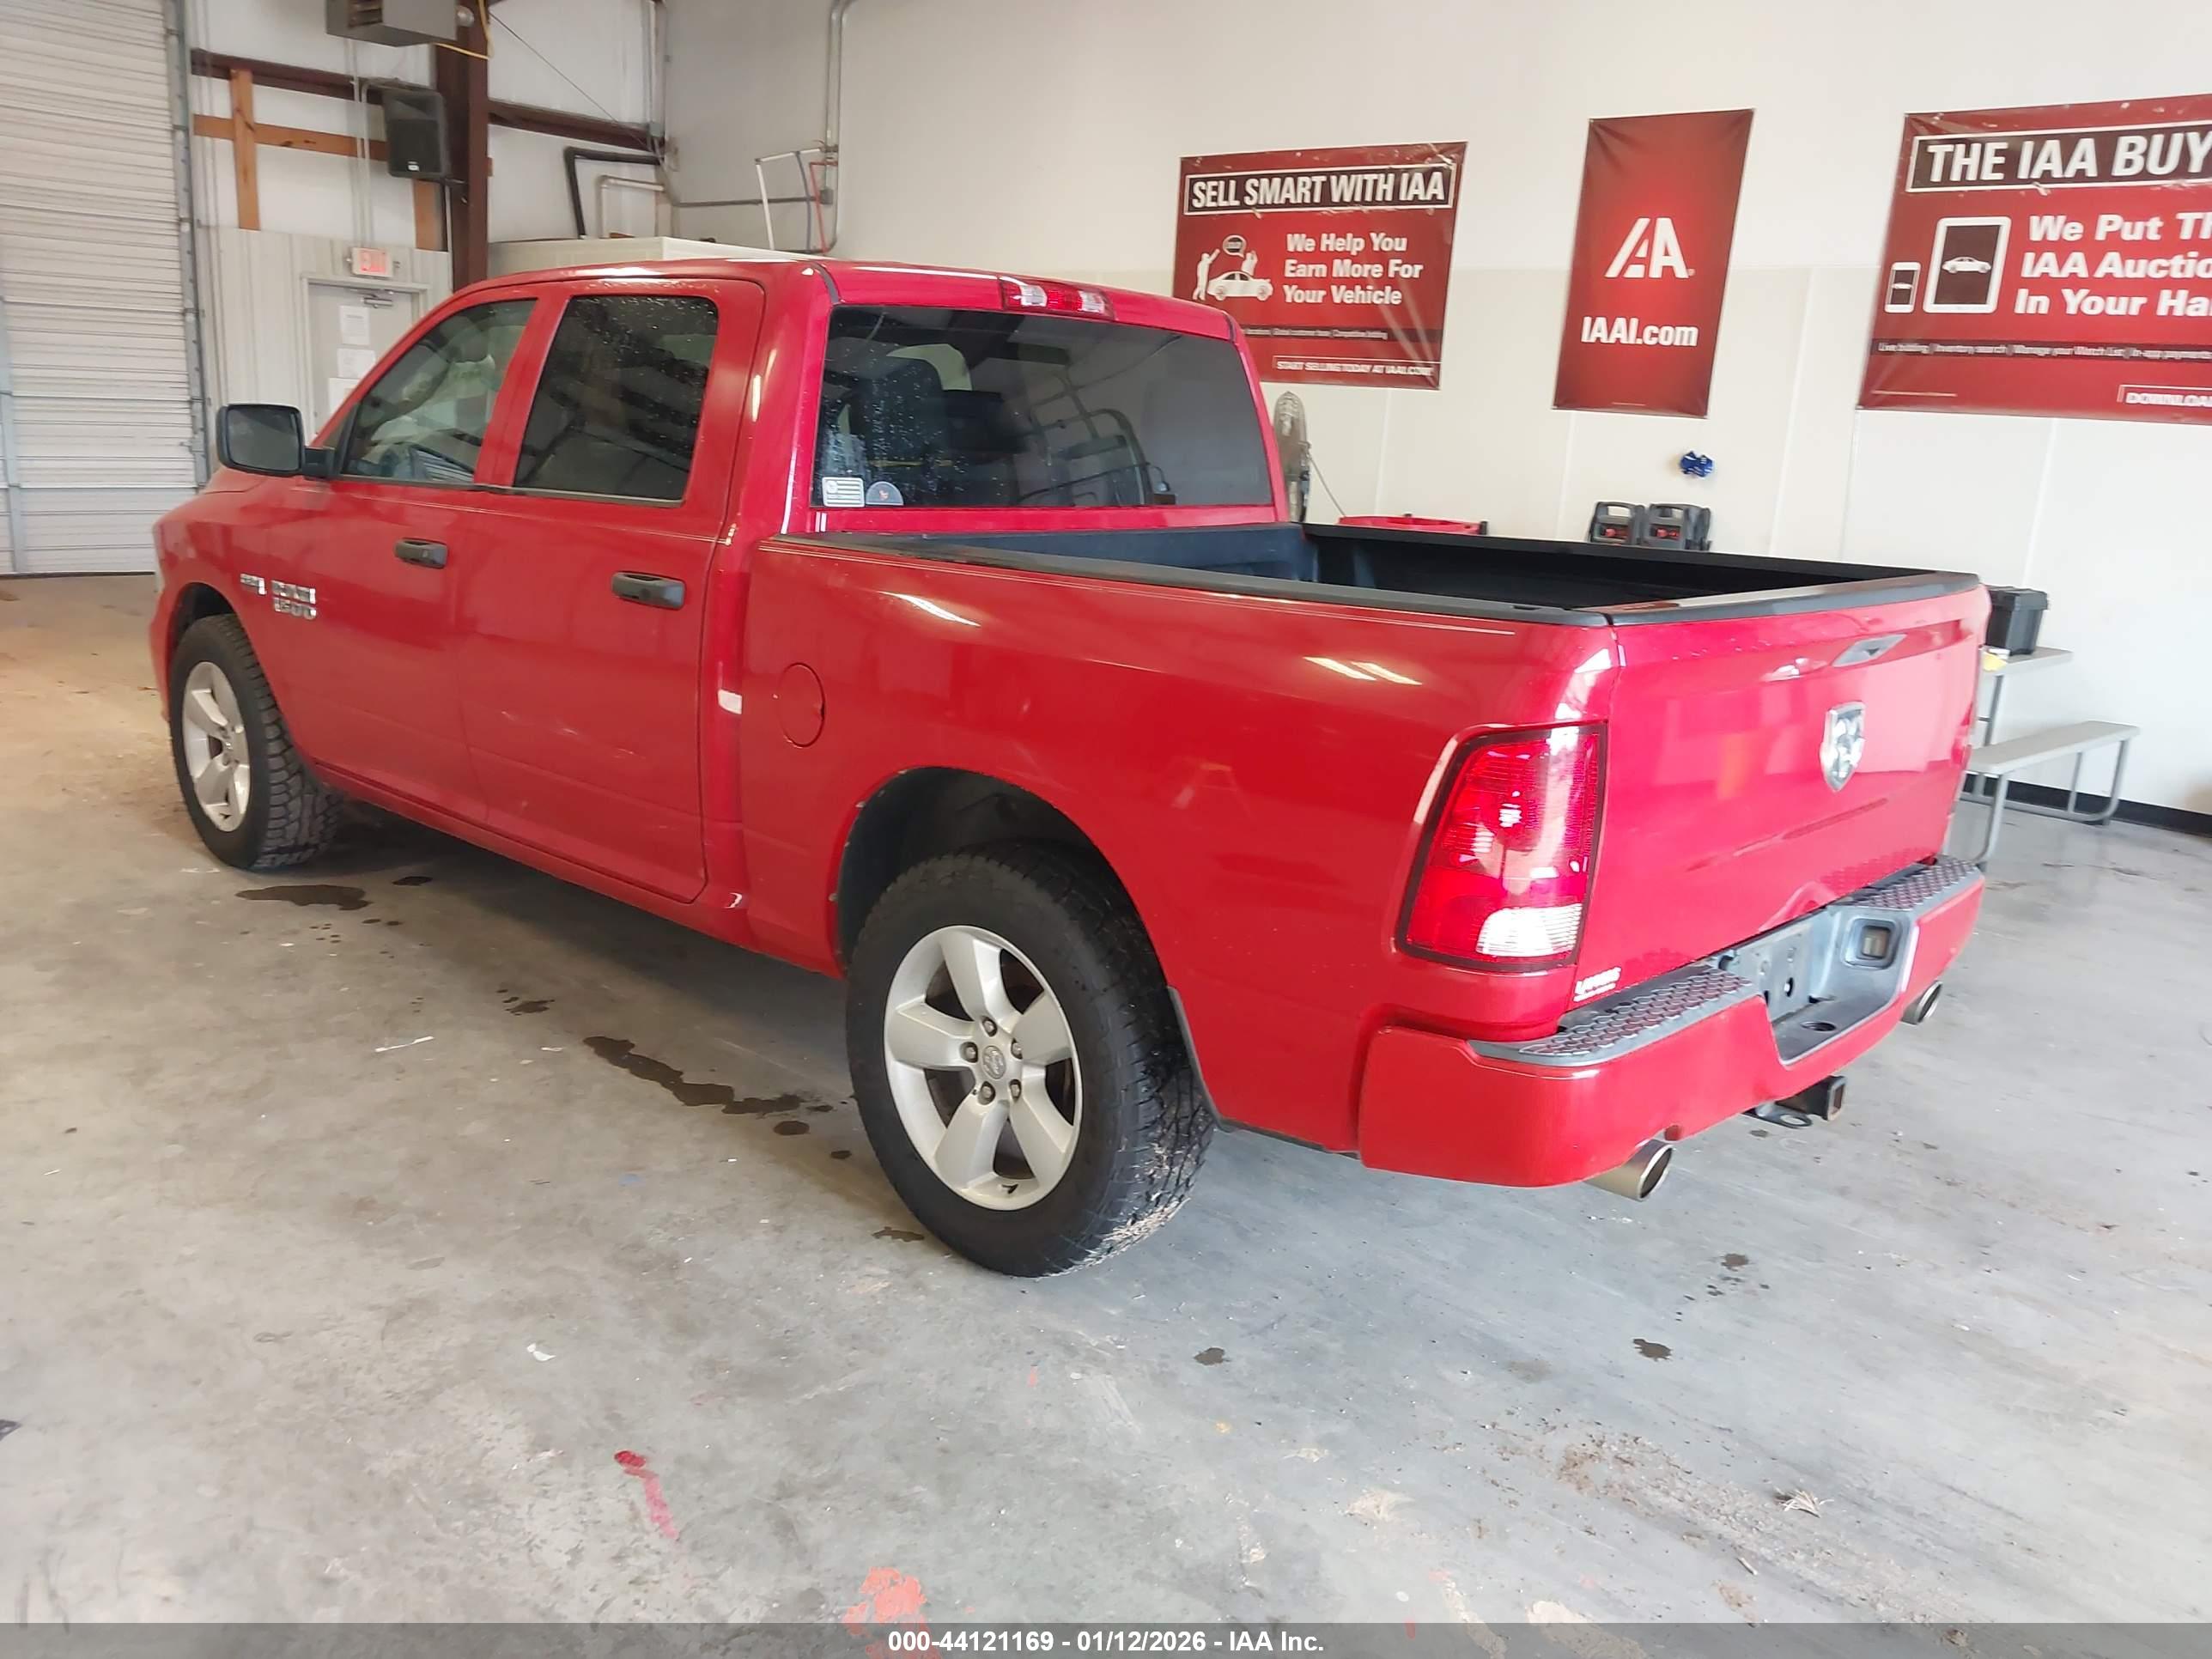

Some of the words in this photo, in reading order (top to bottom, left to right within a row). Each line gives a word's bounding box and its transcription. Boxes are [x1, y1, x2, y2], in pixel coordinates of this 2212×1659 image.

[1927, 142, 2008, 182] THE
[2016, 137, 2098, 179] IAA
[2112, 131, 2212, 177] BUY
[1192, 180, 1240, 208] SELL
[1244, 175, 1327, 206] SMART
[1329, 173, 1397, 203] WITH
[1399, 171, 1445, 201] IAA
[2029, 215, 2083, 241] We
[2094, 213, 2163, 241] Put
[1286, 234, 1316, 252] We
[1321, 233, 1365, 256] Help
[1369, 233, 1408, 252] You
[1284, 259, 1328, 278] Earn
[1332, 259, 1383, 278] More
[1388, 259, 1424, 279] For
[2021, 252, 2089, 278] IAA
[2094, 251, 2212, 278] Auctio
[1283, 284, 1326, 304] Your
[1331, 285, 1403, 305] Vehicle
[2014, 289, 2051, 315] In
[2061, 289, 2148, 316] Your
[2156, 289, 2212, 316] Ha
[1581, 315, 1699, 347] IAAI.com
